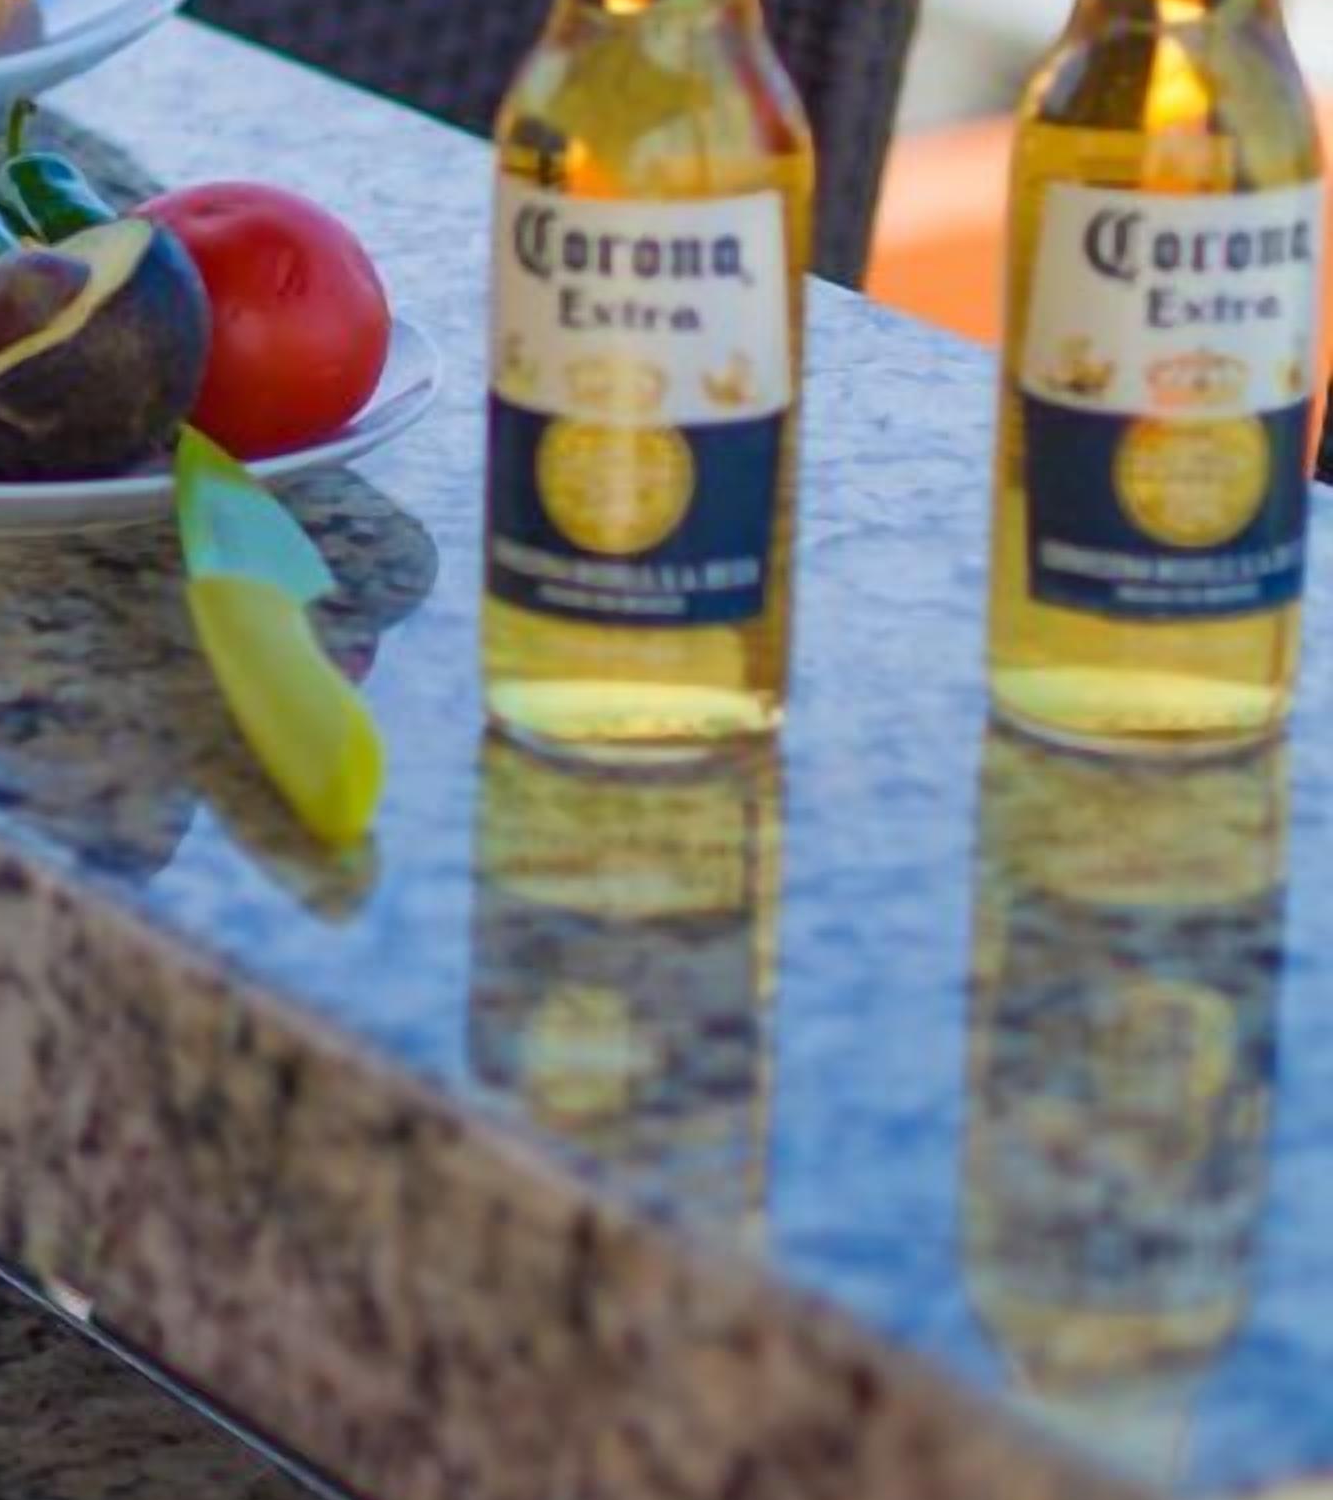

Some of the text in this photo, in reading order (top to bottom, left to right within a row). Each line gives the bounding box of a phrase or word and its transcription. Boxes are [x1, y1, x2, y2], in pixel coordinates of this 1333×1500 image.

[513, 202, 755, 288] Corona
[558, 286, 703, 331] Extra
[1146, 286, 1282, 329] Extra
